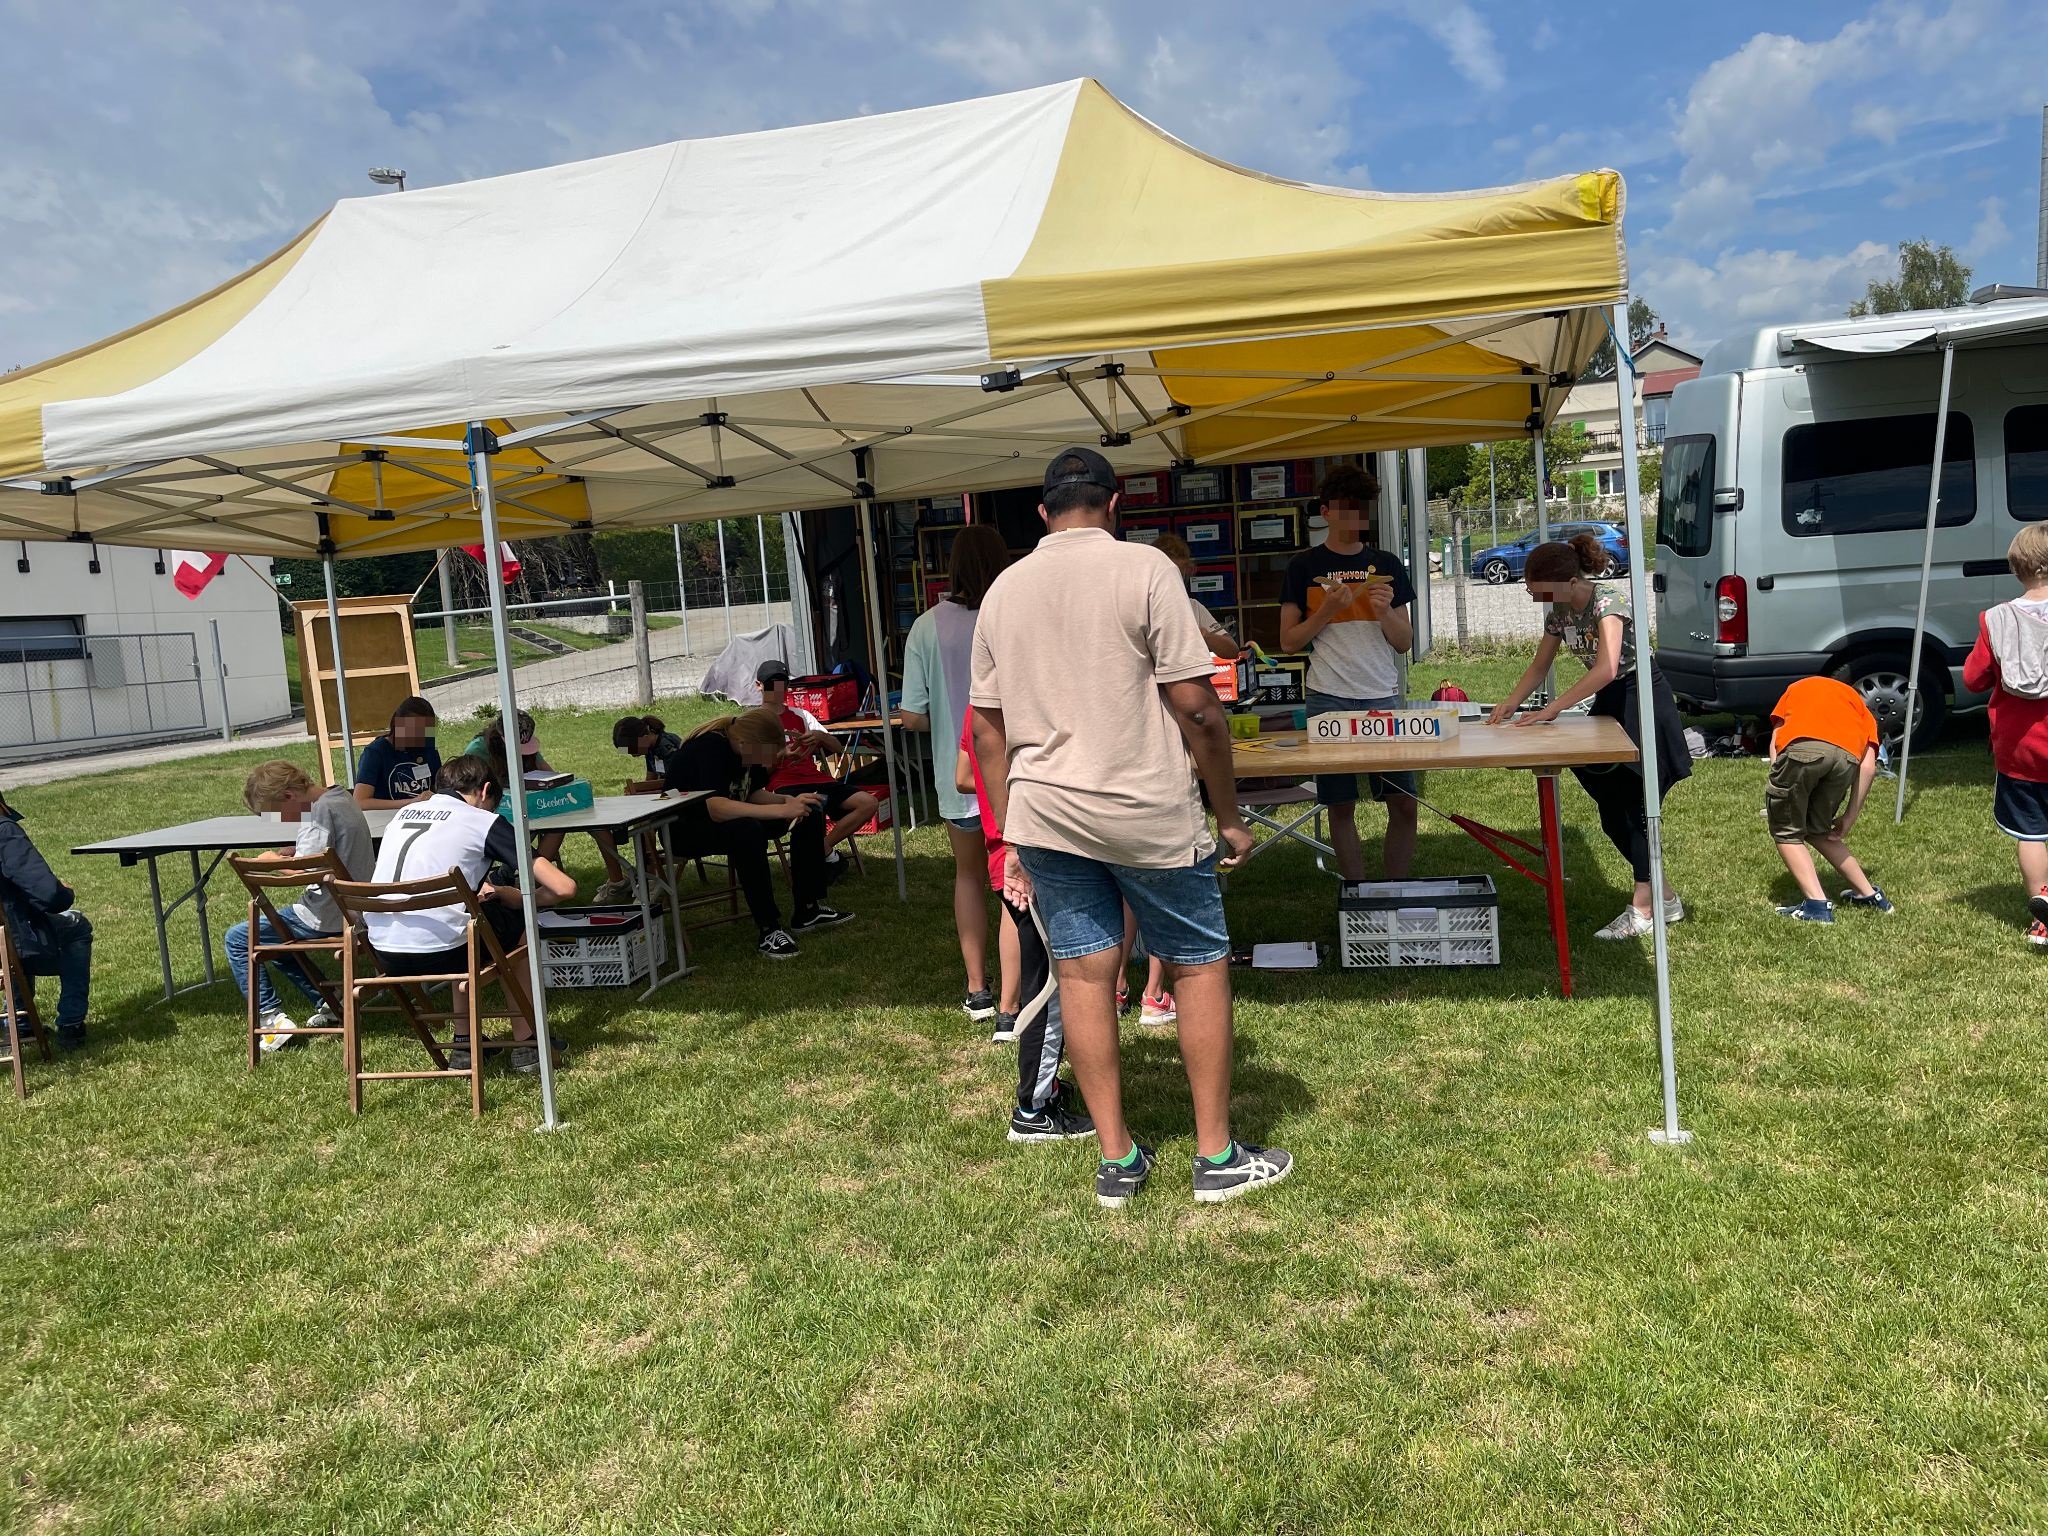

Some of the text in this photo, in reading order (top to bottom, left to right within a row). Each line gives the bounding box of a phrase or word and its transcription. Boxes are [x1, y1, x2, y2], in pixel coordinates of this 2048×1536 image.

[1318, 719, 1341, 737] 60
[1361, 718, 1385, 736] 80
[1398, 717, 1434, 736] 100
[394, 778, 429, 793] NASA
[398, 809, 452, 821] RONALDO
[393, 822, 432, 882] 7
